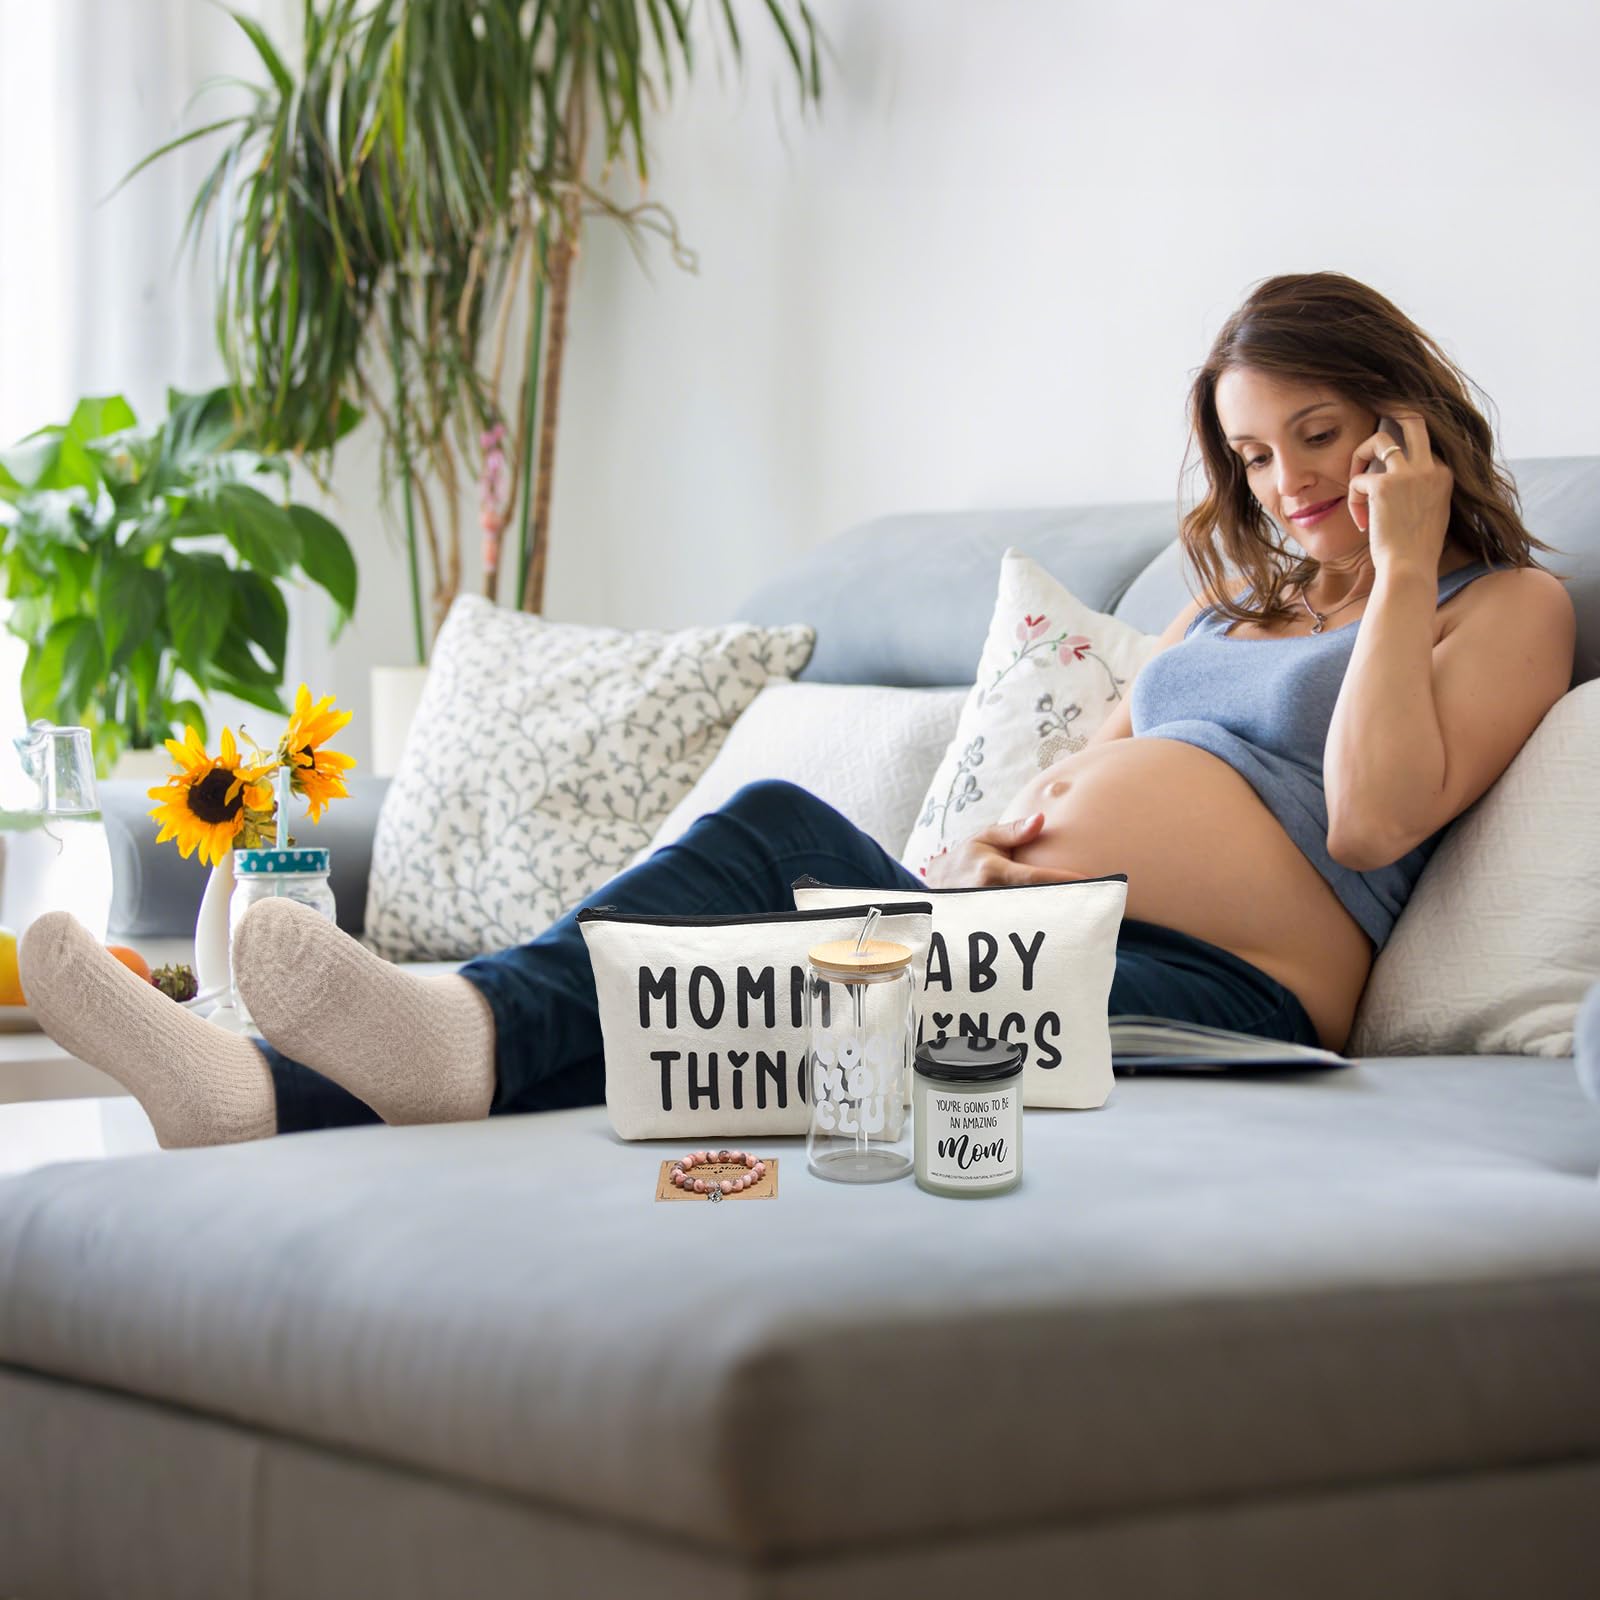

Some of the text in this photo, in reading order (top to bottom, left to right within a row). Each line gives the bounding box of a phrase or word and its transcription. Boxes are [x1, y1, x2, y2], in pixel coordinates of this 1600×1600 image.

[924, 931, 1046, 993] ABY
[936, 1097, 1009, 1113] YOU'RE GOING TO BE
[950, 1116, 998, 1129] AN AMAZING
[938, 1134, 1008, 1170] Mom
